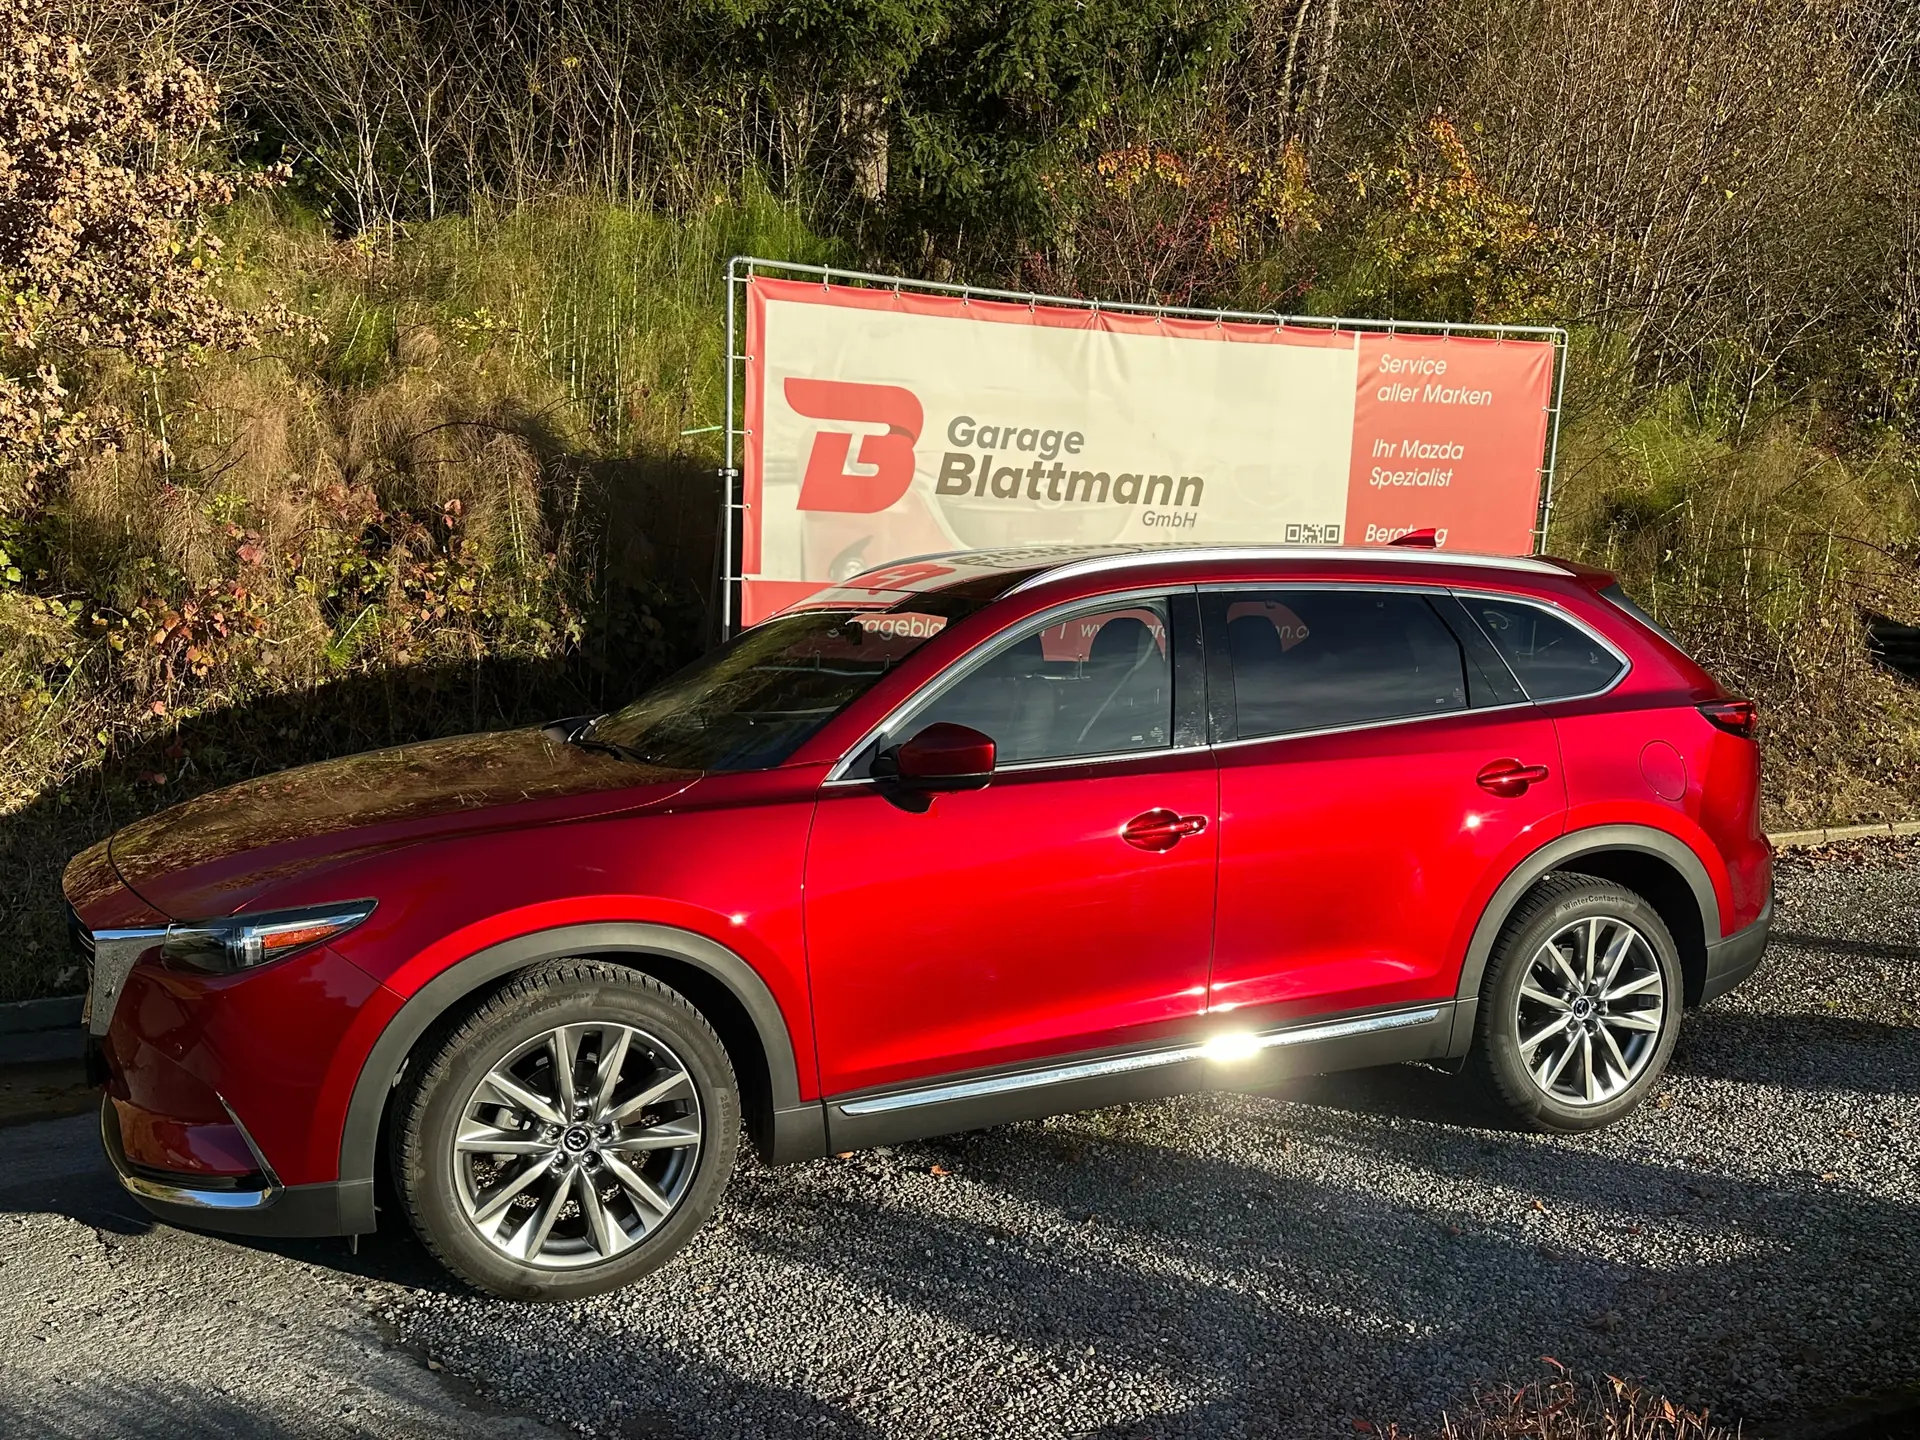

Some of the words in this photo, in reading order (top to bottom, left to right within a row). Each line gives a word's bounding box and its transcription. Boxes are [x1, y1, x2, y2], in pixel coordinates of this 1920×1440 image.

[1379, 353, 1447, 375] Service
[1377, 383, 1419, 402] aller
[1422, 384, 1492, 405] Marken
[947, 415, 1085, 461] Garage
[1372, 439, 1397, 458] Ihr
[1400, 440, 1464, 460] Mazda
[935, 451, 1205, 507] Blattmann
[1369, 466, 1453, 490] Spezialist
[1142, 510, 1197, 528] GmbH
[1562, 895, 1618, 911] WinterContact
